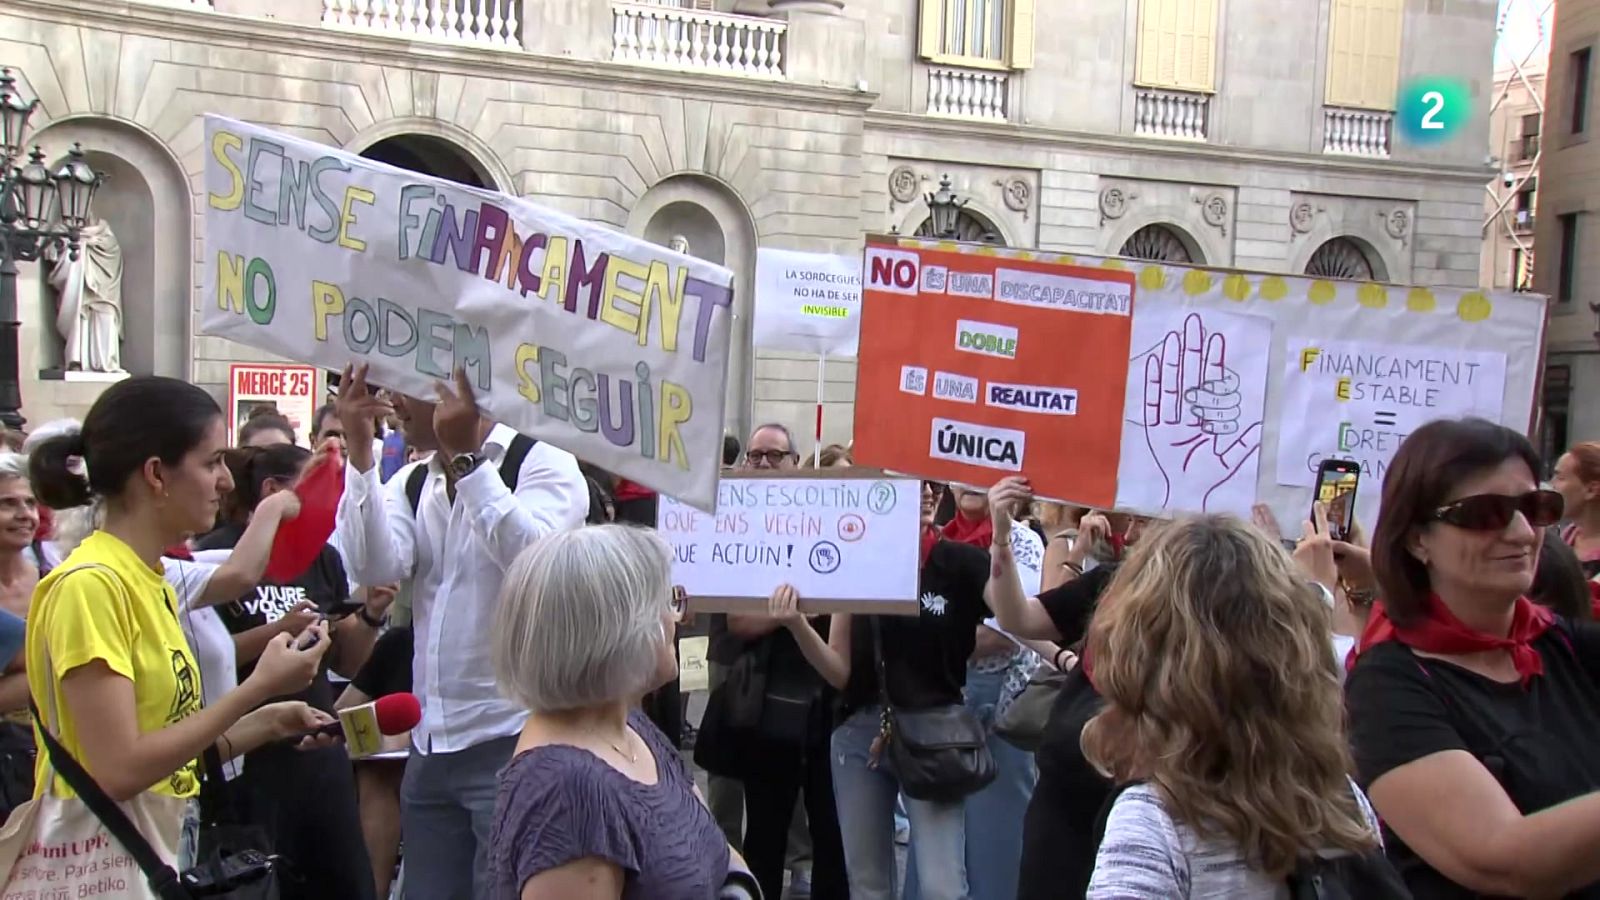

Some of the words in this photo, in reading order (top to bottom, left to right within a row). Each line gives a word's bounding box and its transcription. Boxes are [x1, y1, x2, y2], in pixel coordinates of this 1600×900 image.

[208, 131, 375, 252] SENSE
[785, 269, 797, 280] LA
[870, 255, 917, 289] NO
[926, 268, 945, 290] ÉS
[951, 273, 992, 294] UNA
[1001, 280, 1130, 312] DISCAPACITAT
[793, 287, 809, 298] NO
[811, 289, 825, 299] HA
[828, 290, 839, 300] DE
[842, 292, 859, 302] SER
[217, 250, 276, 325] NO
[312, 279, 492, 392] PODEM
[804, 305, 848, 317] INVISIBLE
[958, 329, 1017, 357] DOBLE
[289, 372, 309, 397] 25
[905, 369, 925, 392] ÉS
[935, 377, 974, 400] UNA
[991, 386, 1076, 411] REALITAT
[1337, 380, 1441, 407] ESTABLE
[937, 424, 1019, 465] ÚNICA
[719, 483, 758, 508] ENS
[664, 511, 699, 532] QUE
[715, 511, 749, 535] ENS
[673, 543, 697, 564] UE
[256, 585, 307, 603] VIURE
[65, 861, 98, 879] Para
